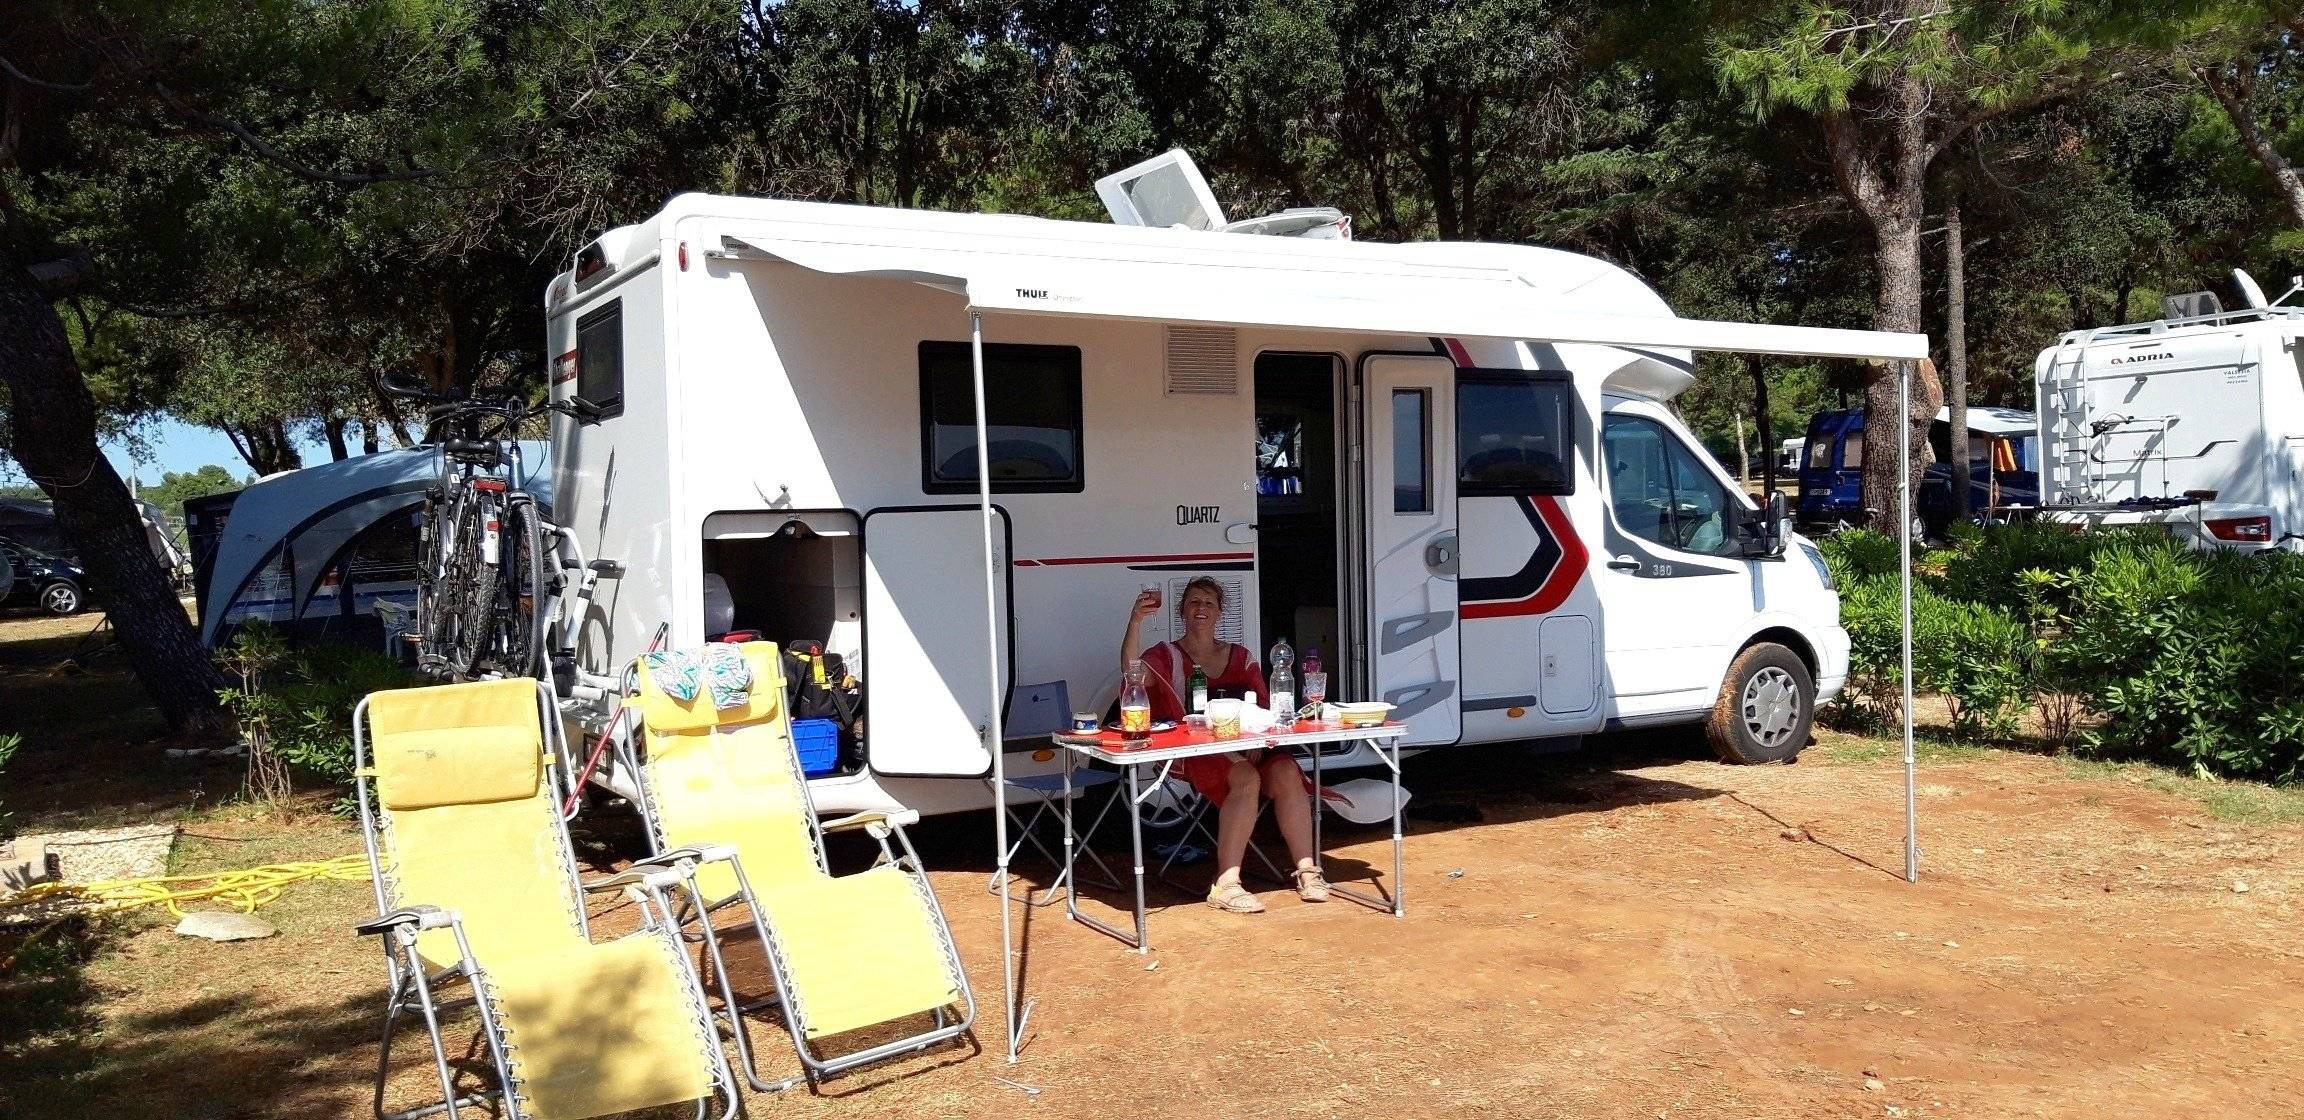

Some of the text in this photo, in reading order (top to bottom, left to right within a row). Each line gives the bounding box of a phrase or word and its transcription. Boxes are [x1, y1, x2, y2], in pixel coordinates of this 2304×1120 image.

[1016, 288, 1048, 299] THULE
[2126, 352, 2174, 363] ADRIA
[1177, 505, 1220, 525] QUARTZ
[1653, 564, 1672, 576] 380
